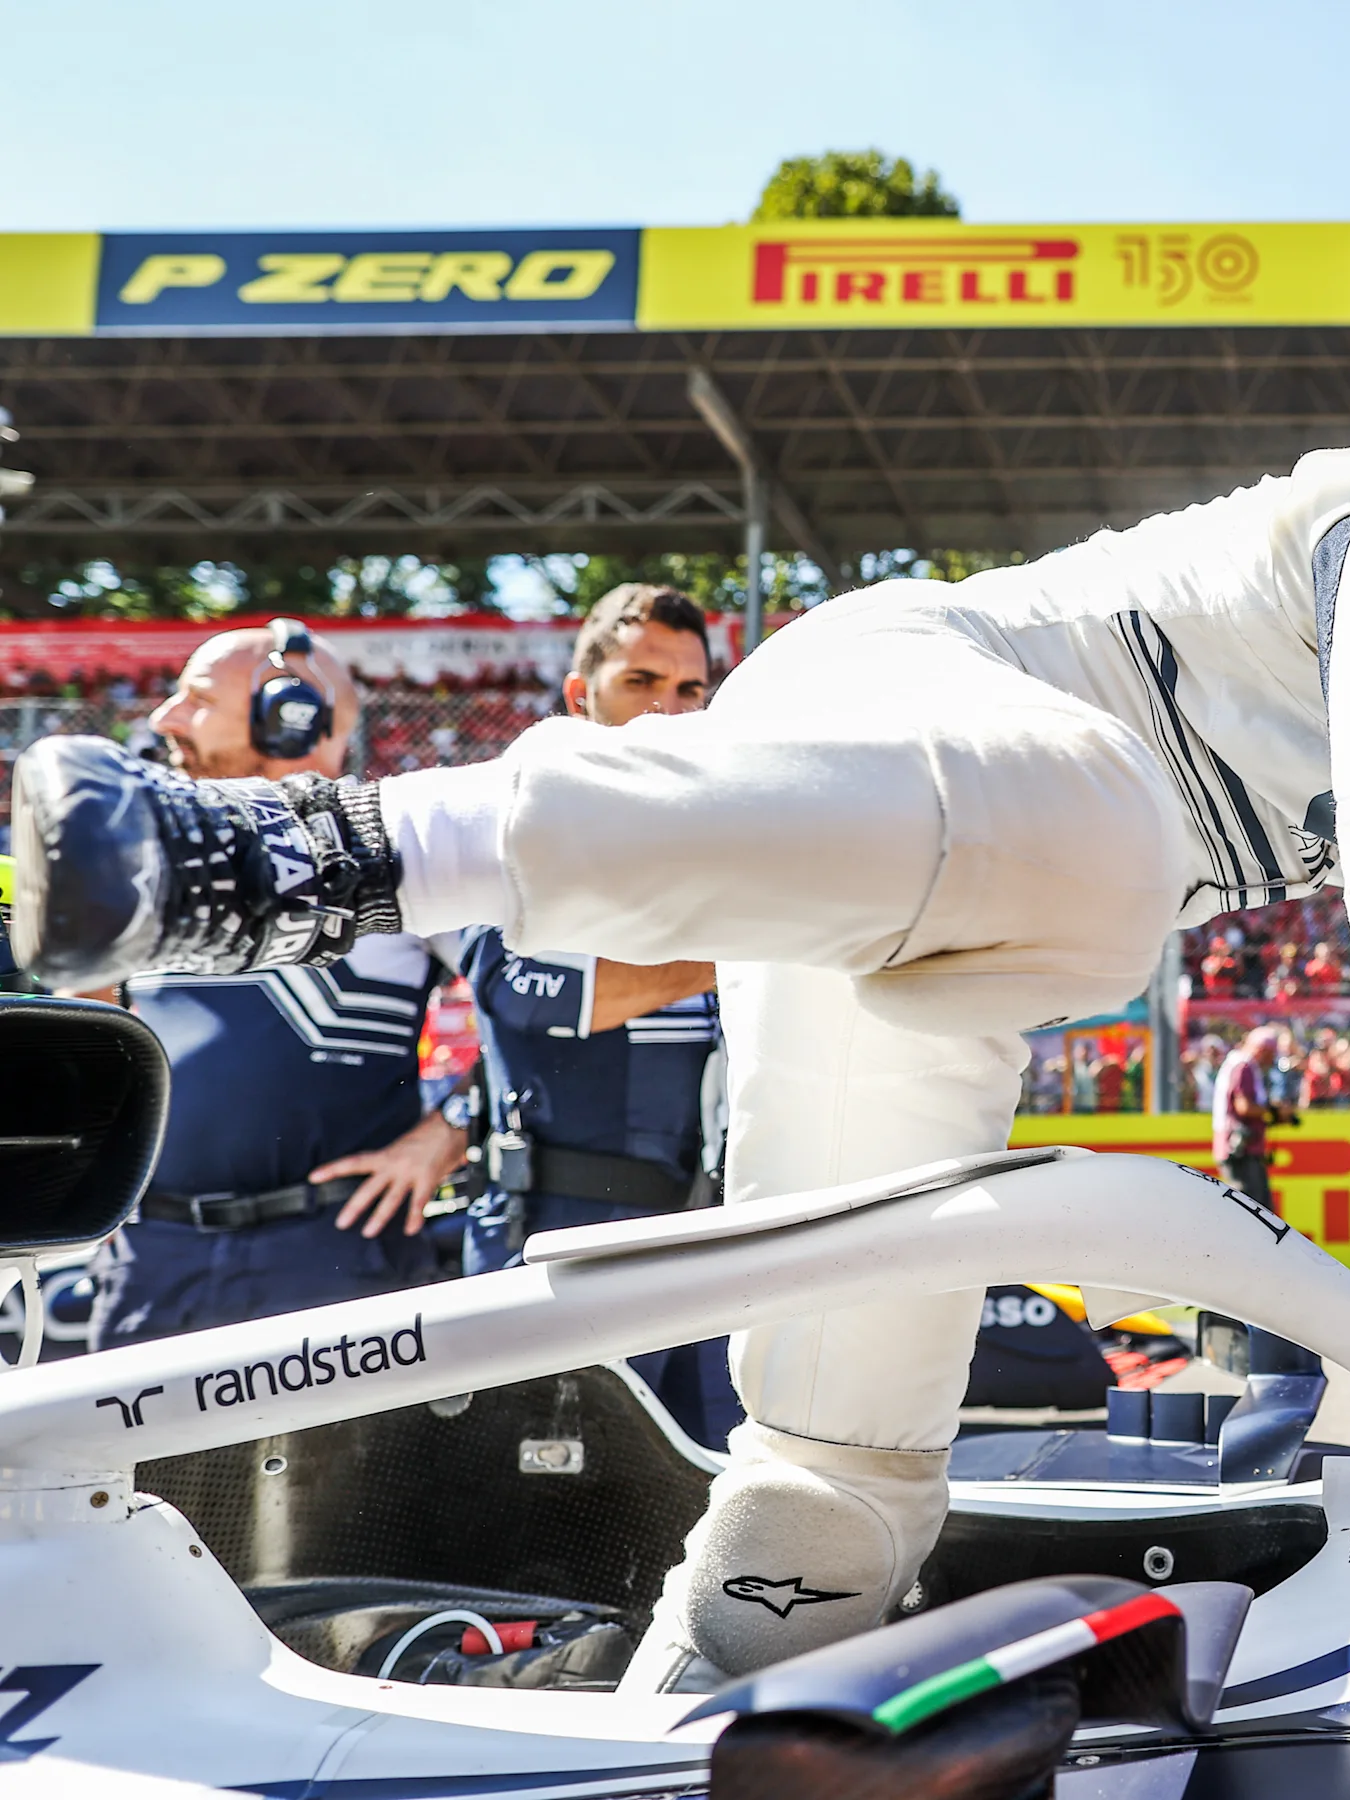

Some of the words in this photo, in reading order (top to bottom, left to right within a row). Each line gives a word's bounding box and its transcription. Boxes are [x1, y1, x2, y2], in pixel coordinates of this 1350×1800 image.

[120, 253, 226, 304] P
[238, 249, 616, 304] ZERO
[752, 237, 1081, 304] PIRELLI
[1115, 233, 1260, 308] 150
[195, 1312, 426, 1412] randstad
